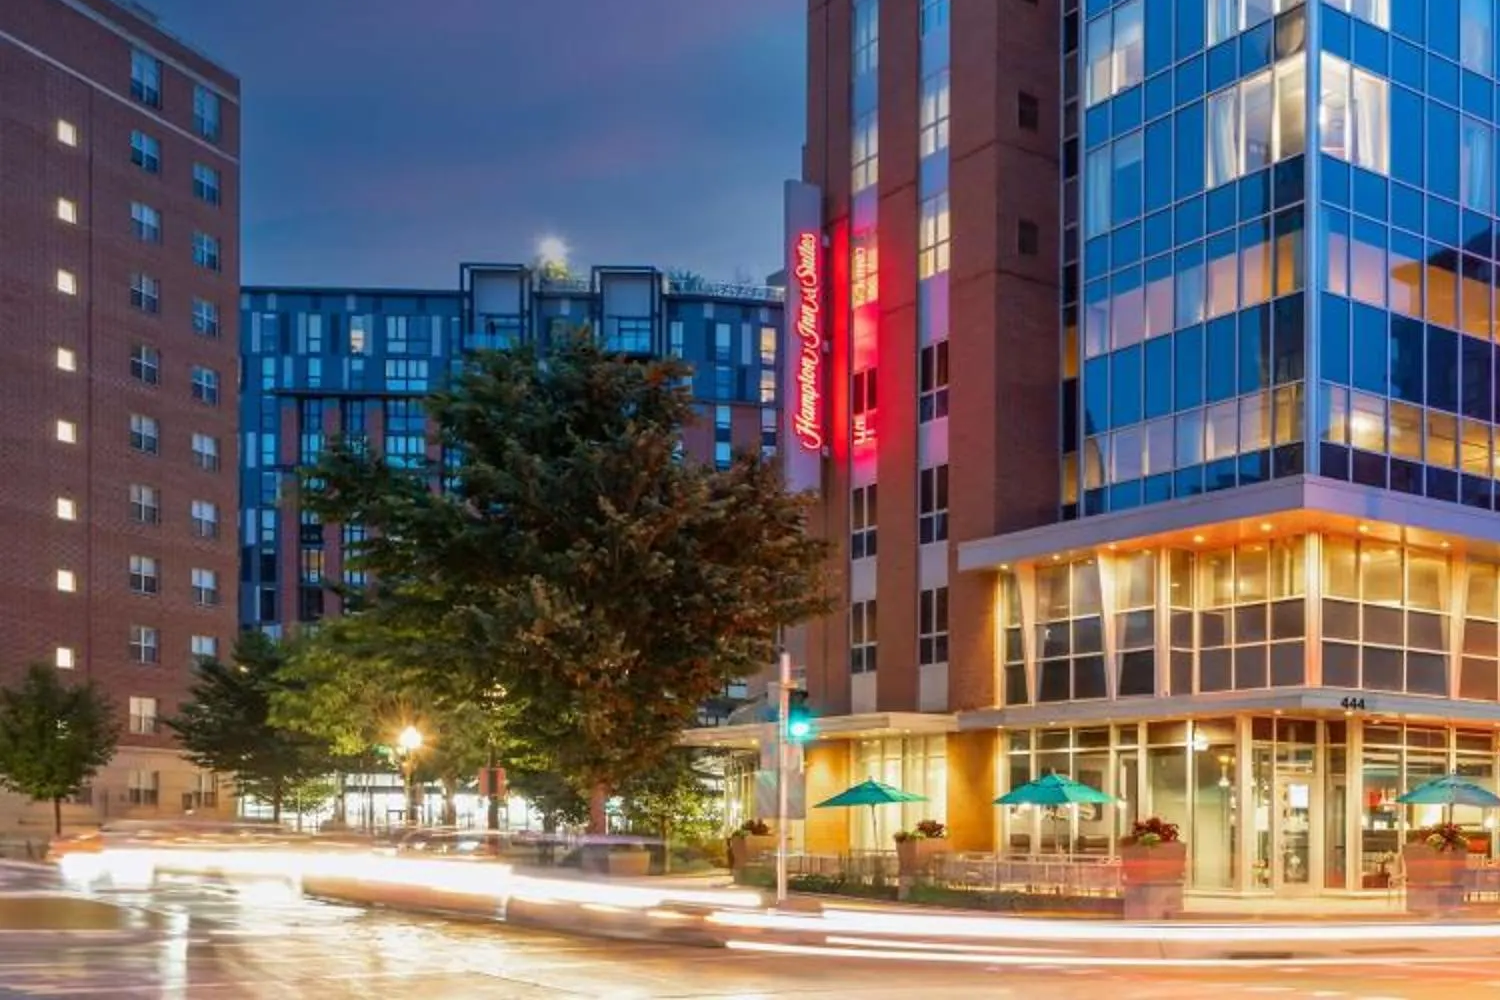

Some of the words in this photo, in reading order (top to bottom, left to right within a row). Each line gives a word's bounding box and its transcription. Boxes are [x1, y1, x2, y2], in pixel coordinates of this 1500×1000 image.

[795, 233, 817, 286] Suites
[797, 299, 820, 348] Inn
[795, 348, 821, 449] Hampton
[1340, 697, 1365, 710] 444
